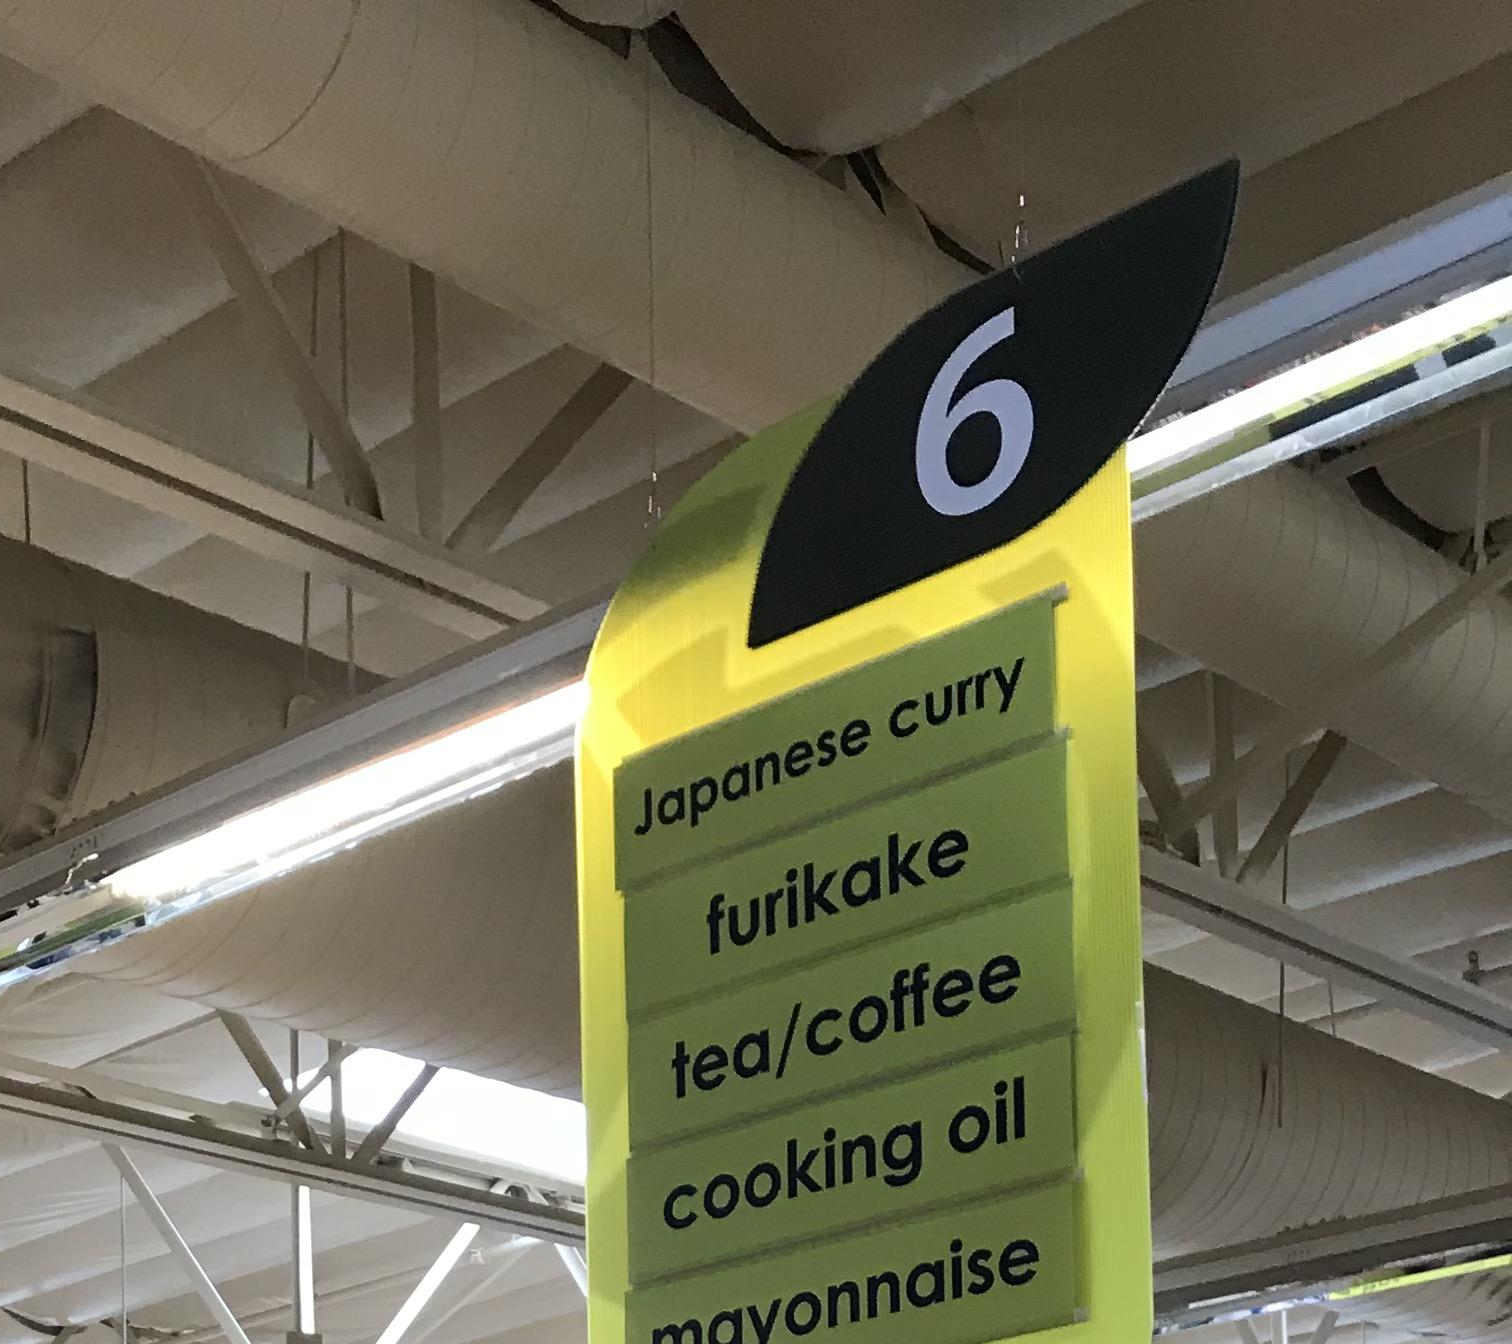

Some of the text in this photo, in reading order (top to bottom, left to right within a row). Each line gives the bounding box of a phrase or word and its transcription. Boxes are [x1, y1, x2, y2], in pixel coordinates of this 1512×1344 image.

[915, 306, 1034, 516] 6
[634, 657, 1025, 835] Japanese curry
[706, 828, 969, 954] furikake
[671, 954, 1021, 1098] tea/coffee
[663, 1076, 1026, 1229] cooking oil
